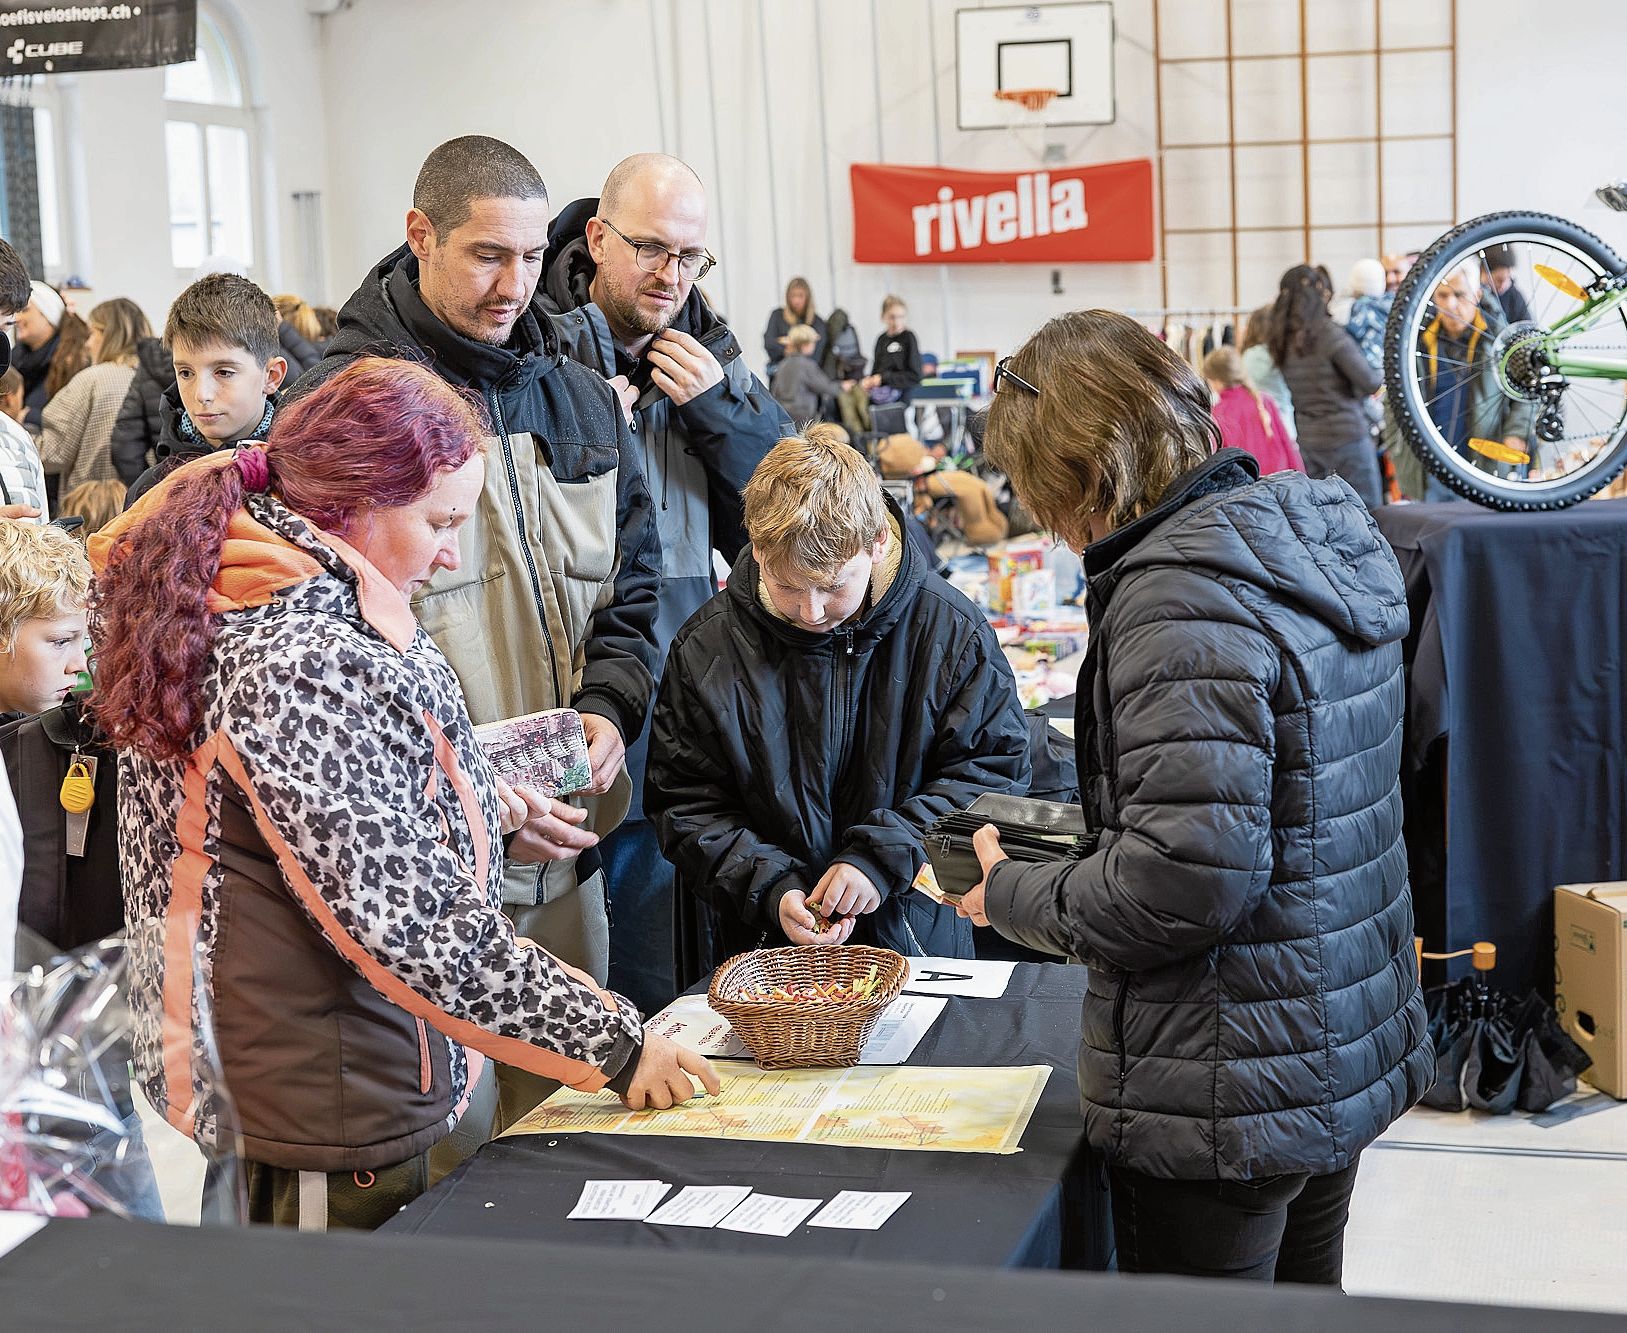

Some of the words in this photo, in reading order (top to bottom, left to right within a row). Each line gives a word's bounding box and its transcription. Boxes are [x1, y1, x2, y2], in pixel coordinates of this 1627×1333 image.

[0, 3, 131, 27] oefisveloshops.ch
[25, 41, 84, 58] CUBE
[912, 172, 1089, 257] rivella
[914, 970, 974, 982] A
